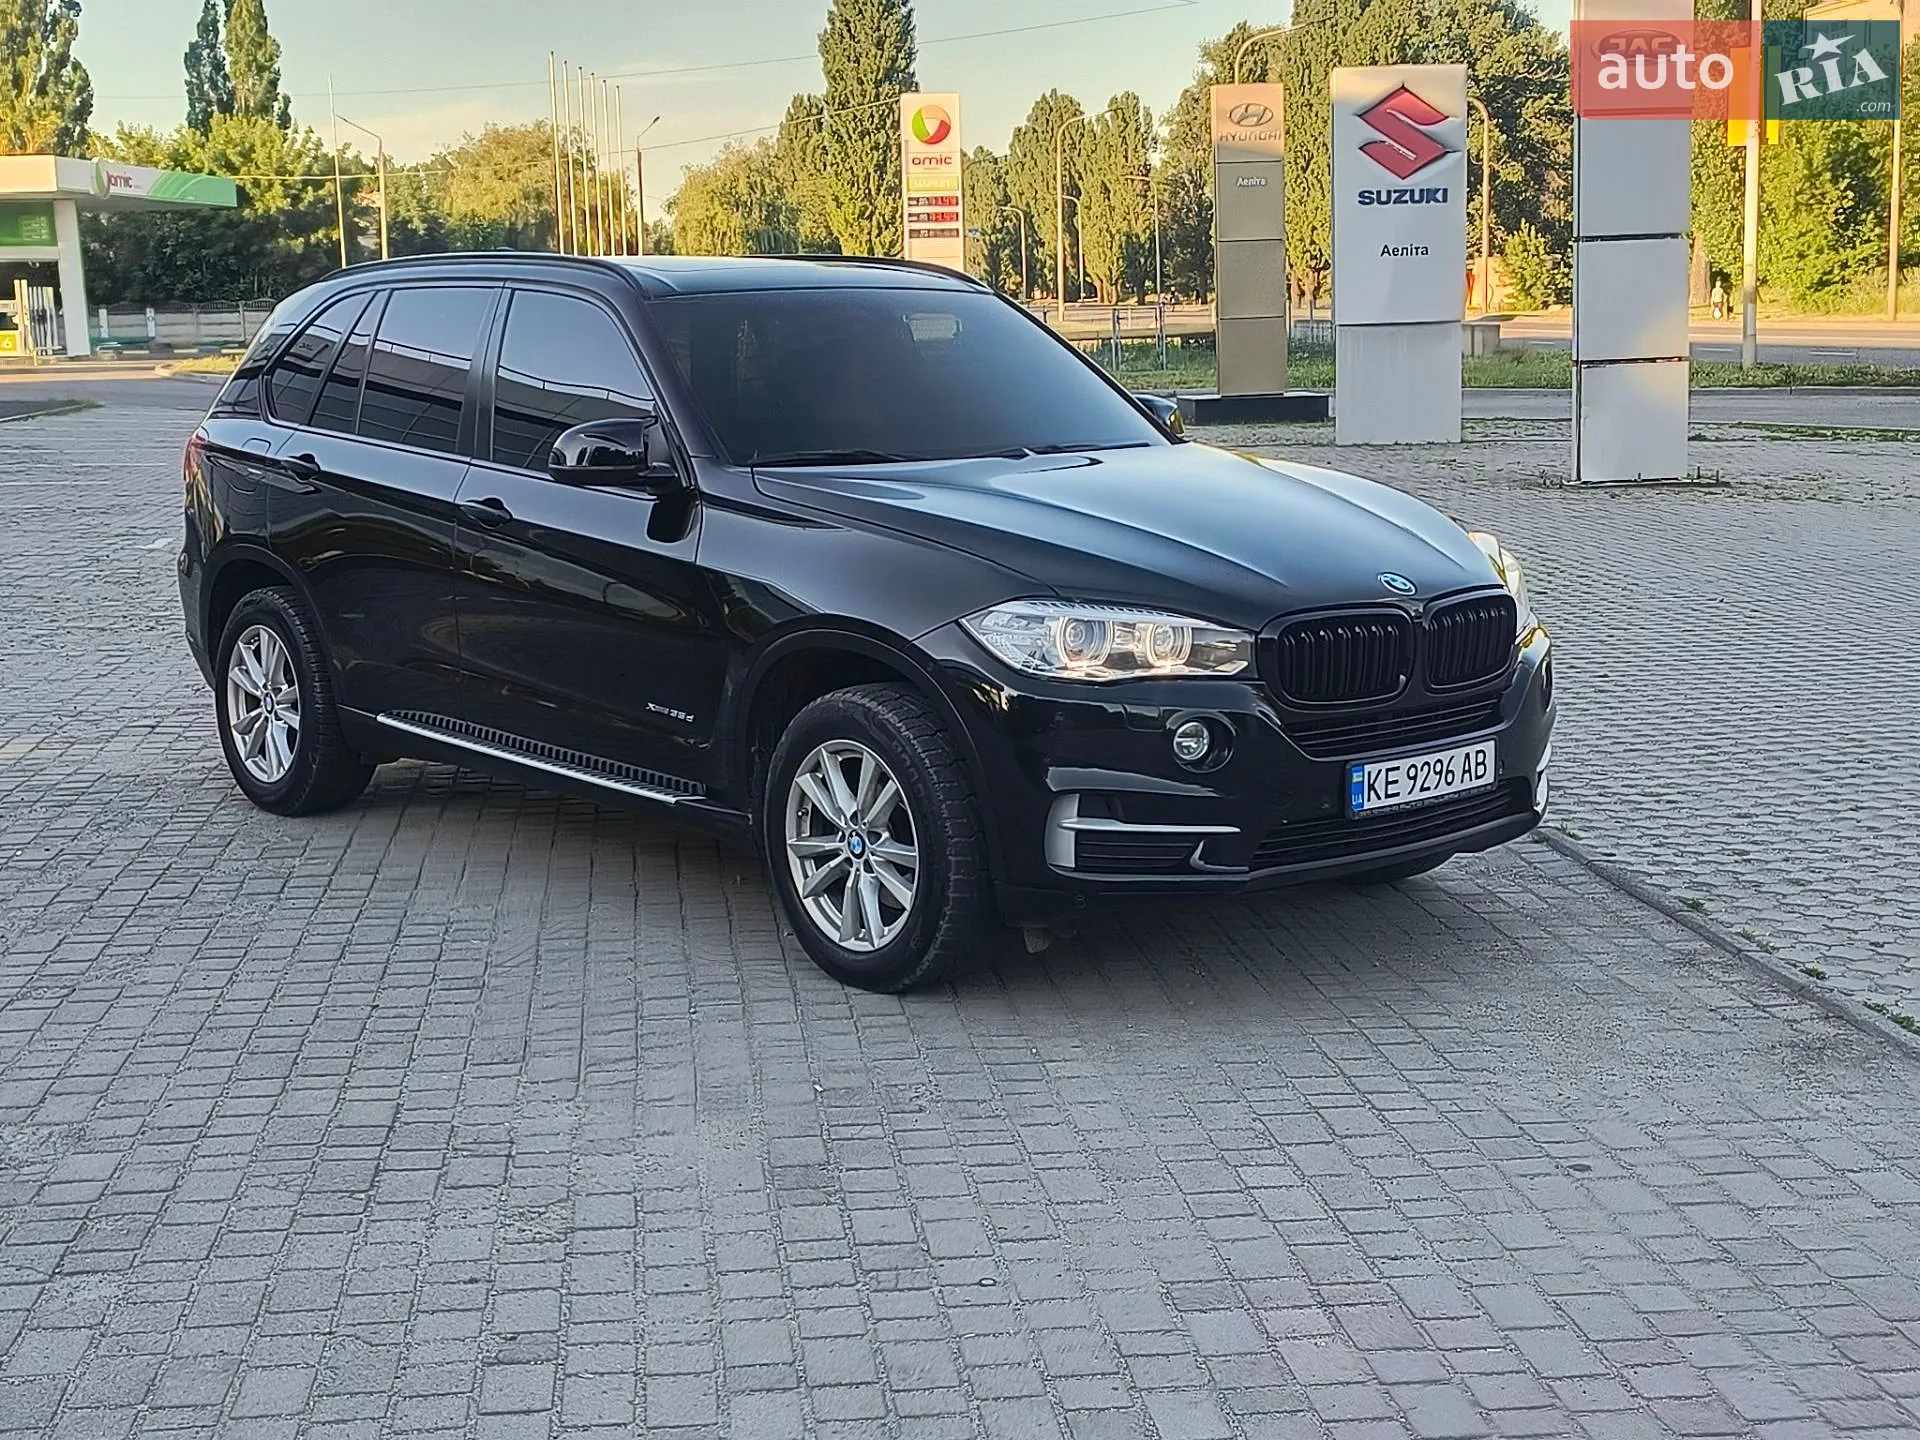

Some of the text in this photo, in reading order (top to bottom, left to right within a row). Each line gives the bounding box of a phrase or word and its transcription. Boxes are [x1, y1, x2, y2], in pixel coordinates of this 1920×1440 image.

[1607, 37, 1673, 54] JAC
[1219, 130, 1282, 142] HYUNDAI
[911, 154, 953, 166] amic
[1357, 187, 1449, 206] SUZUKI
[1380, 243, 1429, 258] Аеліта
[1366, 748, 1487, 803] KE 9296 AB
[1352, 793, 1363, 805] UA
